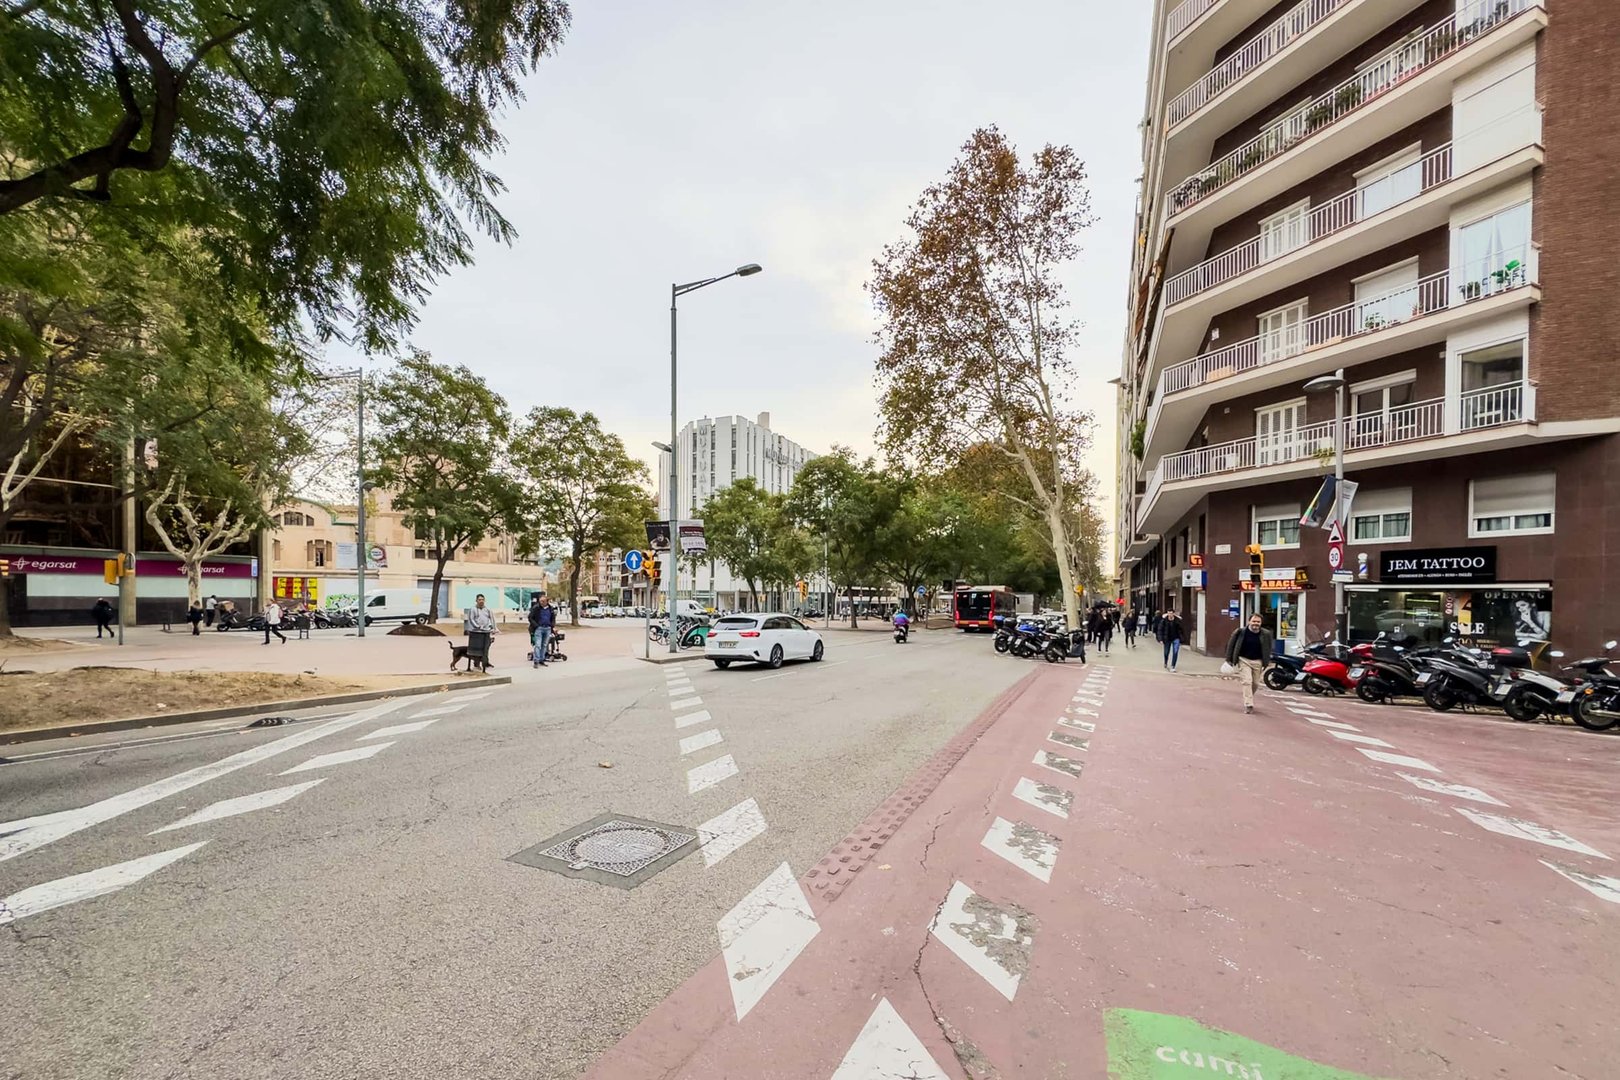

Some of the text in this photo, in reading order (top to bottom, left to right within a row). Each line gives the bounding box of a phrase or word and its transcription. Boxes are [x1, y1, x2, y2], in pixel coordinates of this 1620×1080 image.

[31, 561, 77, 570] egarsat
[1388, 557, 1485, 572] JEM TATTOO
